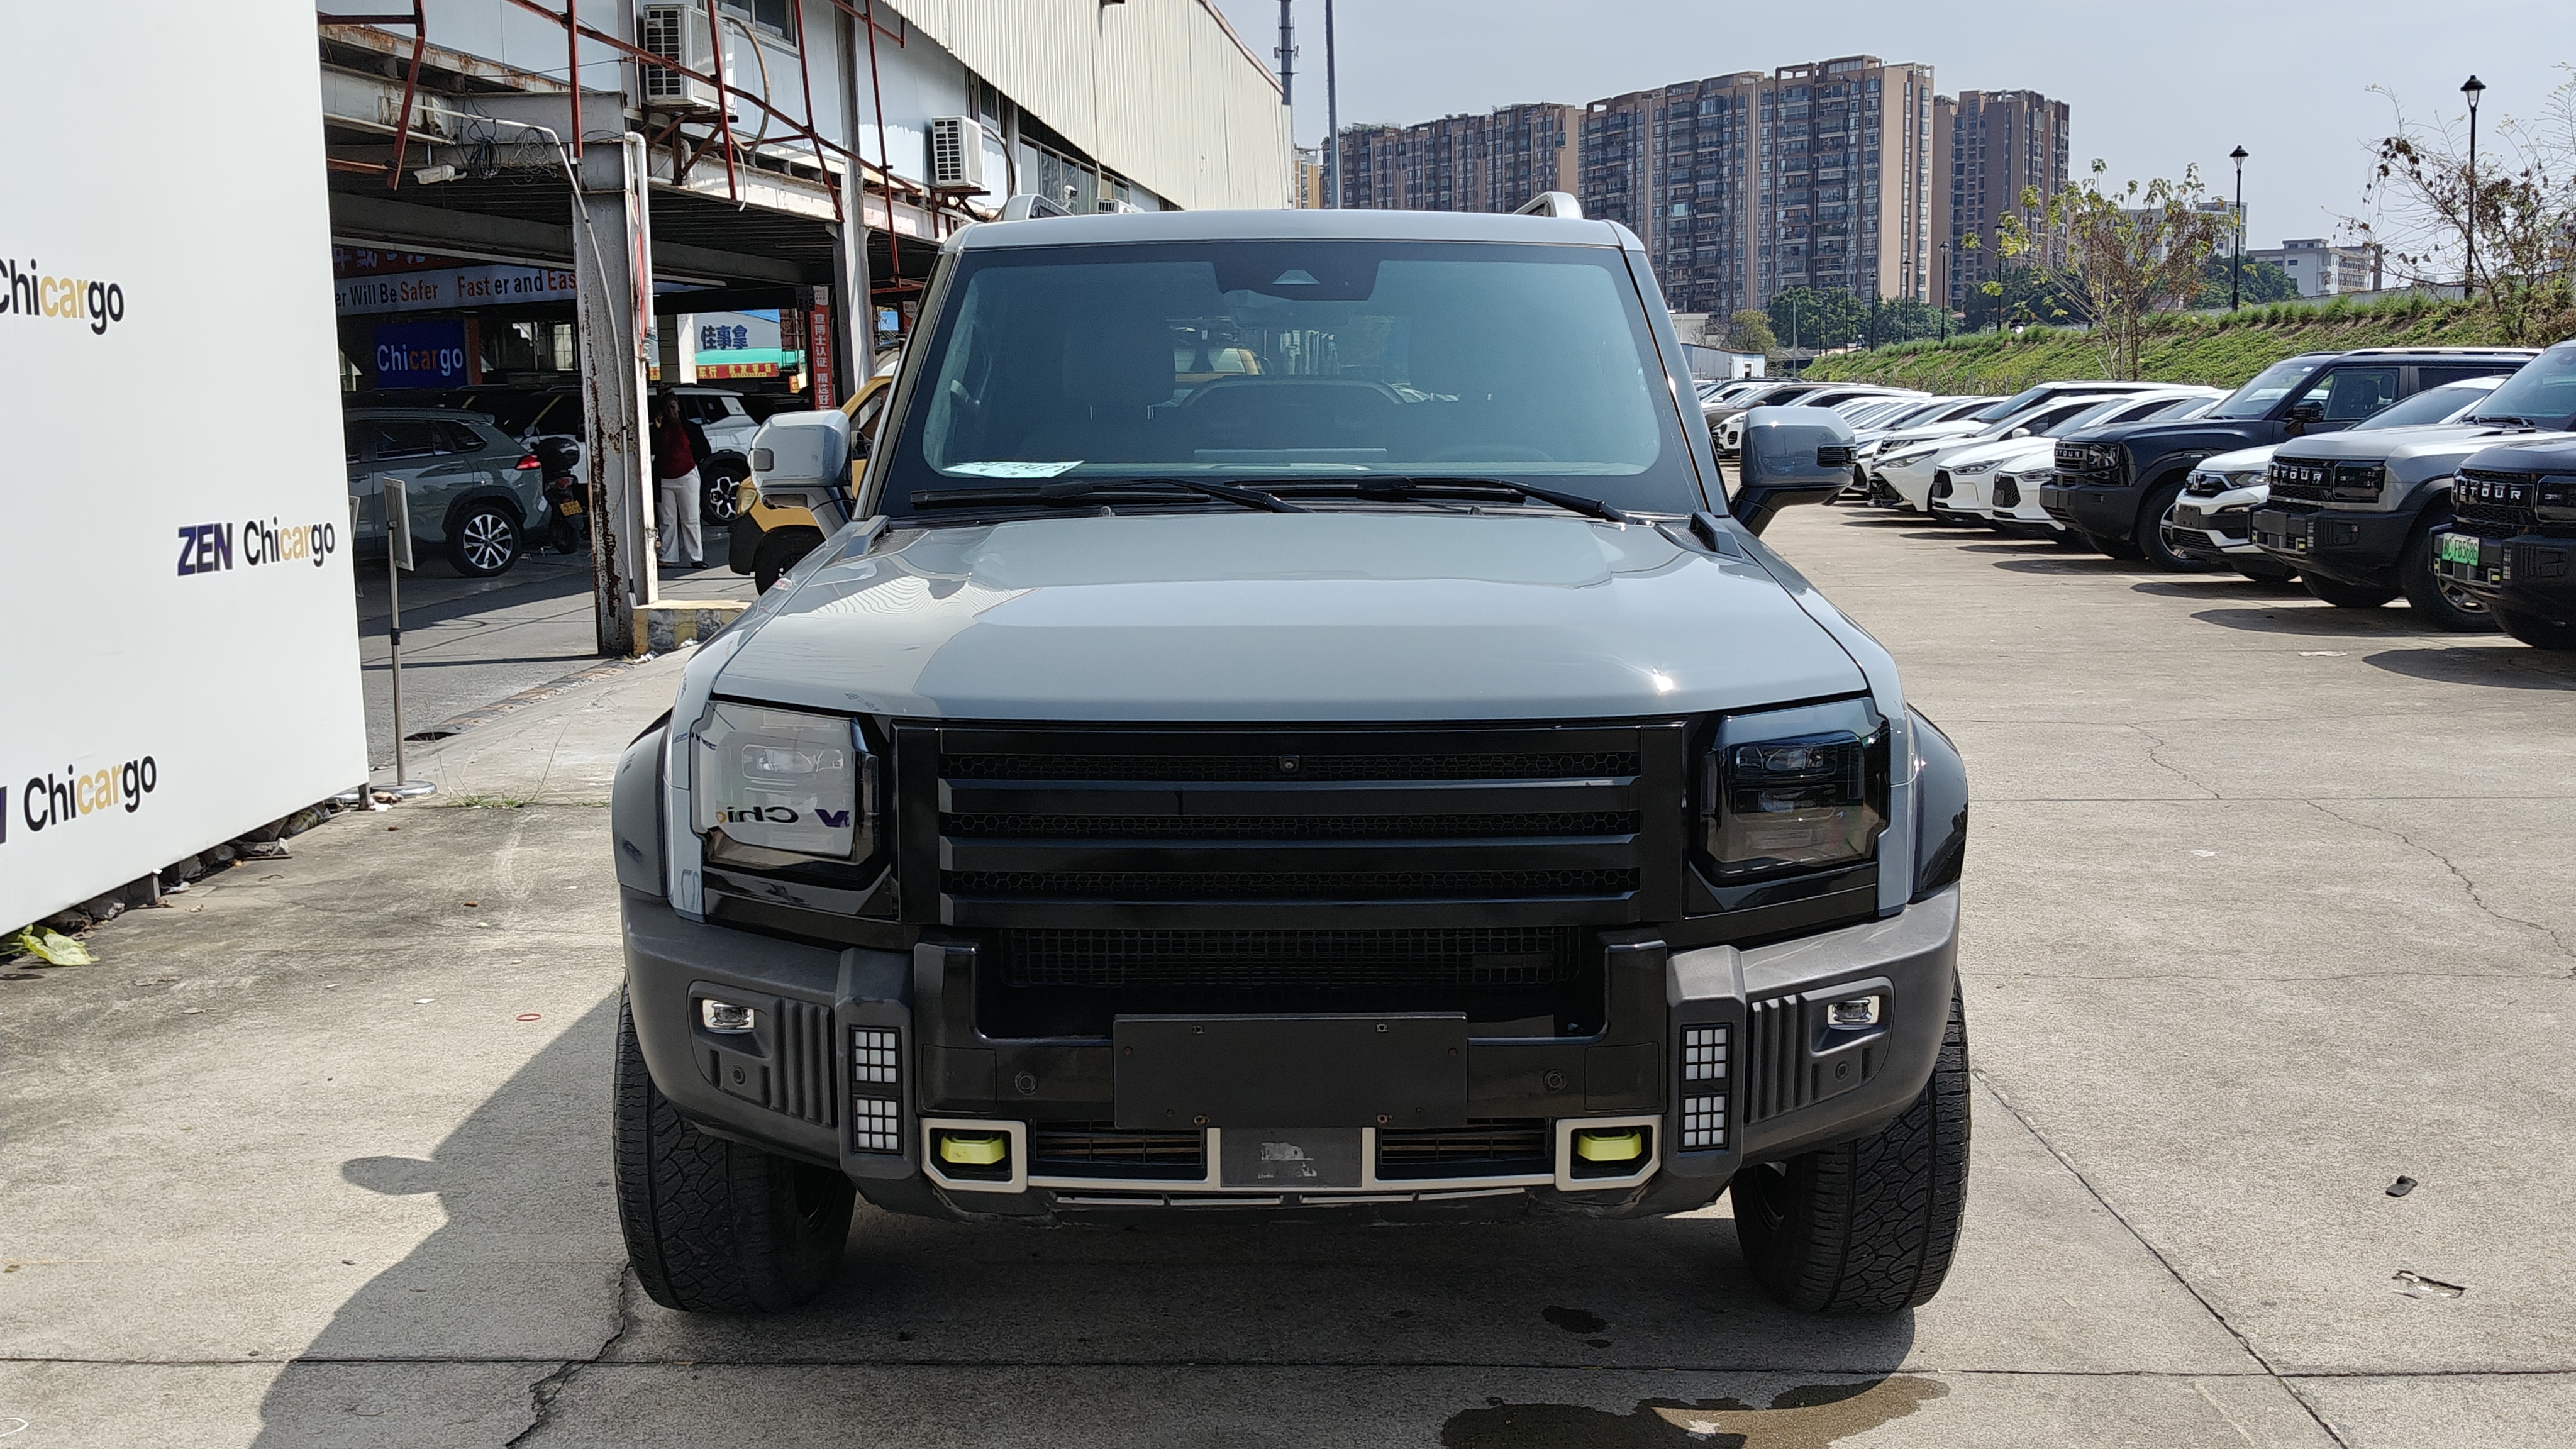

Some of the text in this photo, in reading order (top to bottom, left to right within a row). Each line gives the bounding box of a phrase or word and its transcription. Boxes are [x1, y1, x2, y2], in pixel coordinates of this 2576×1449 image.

[350, 284, 376, 306] Will
[380, 283, 397, 303] Be
[401, 280, 438, 301] Safer
[514, 270, 543, 293] and
[377, 344, 463, 376] Chicargo
[2268, 469, 2322, 481] ETOUR
[2453, 485, 2521, 500] ETOUR
[177, 516, 335, 577] ZEN Chicargo
[24, 755, 157, 832] Chicargo
